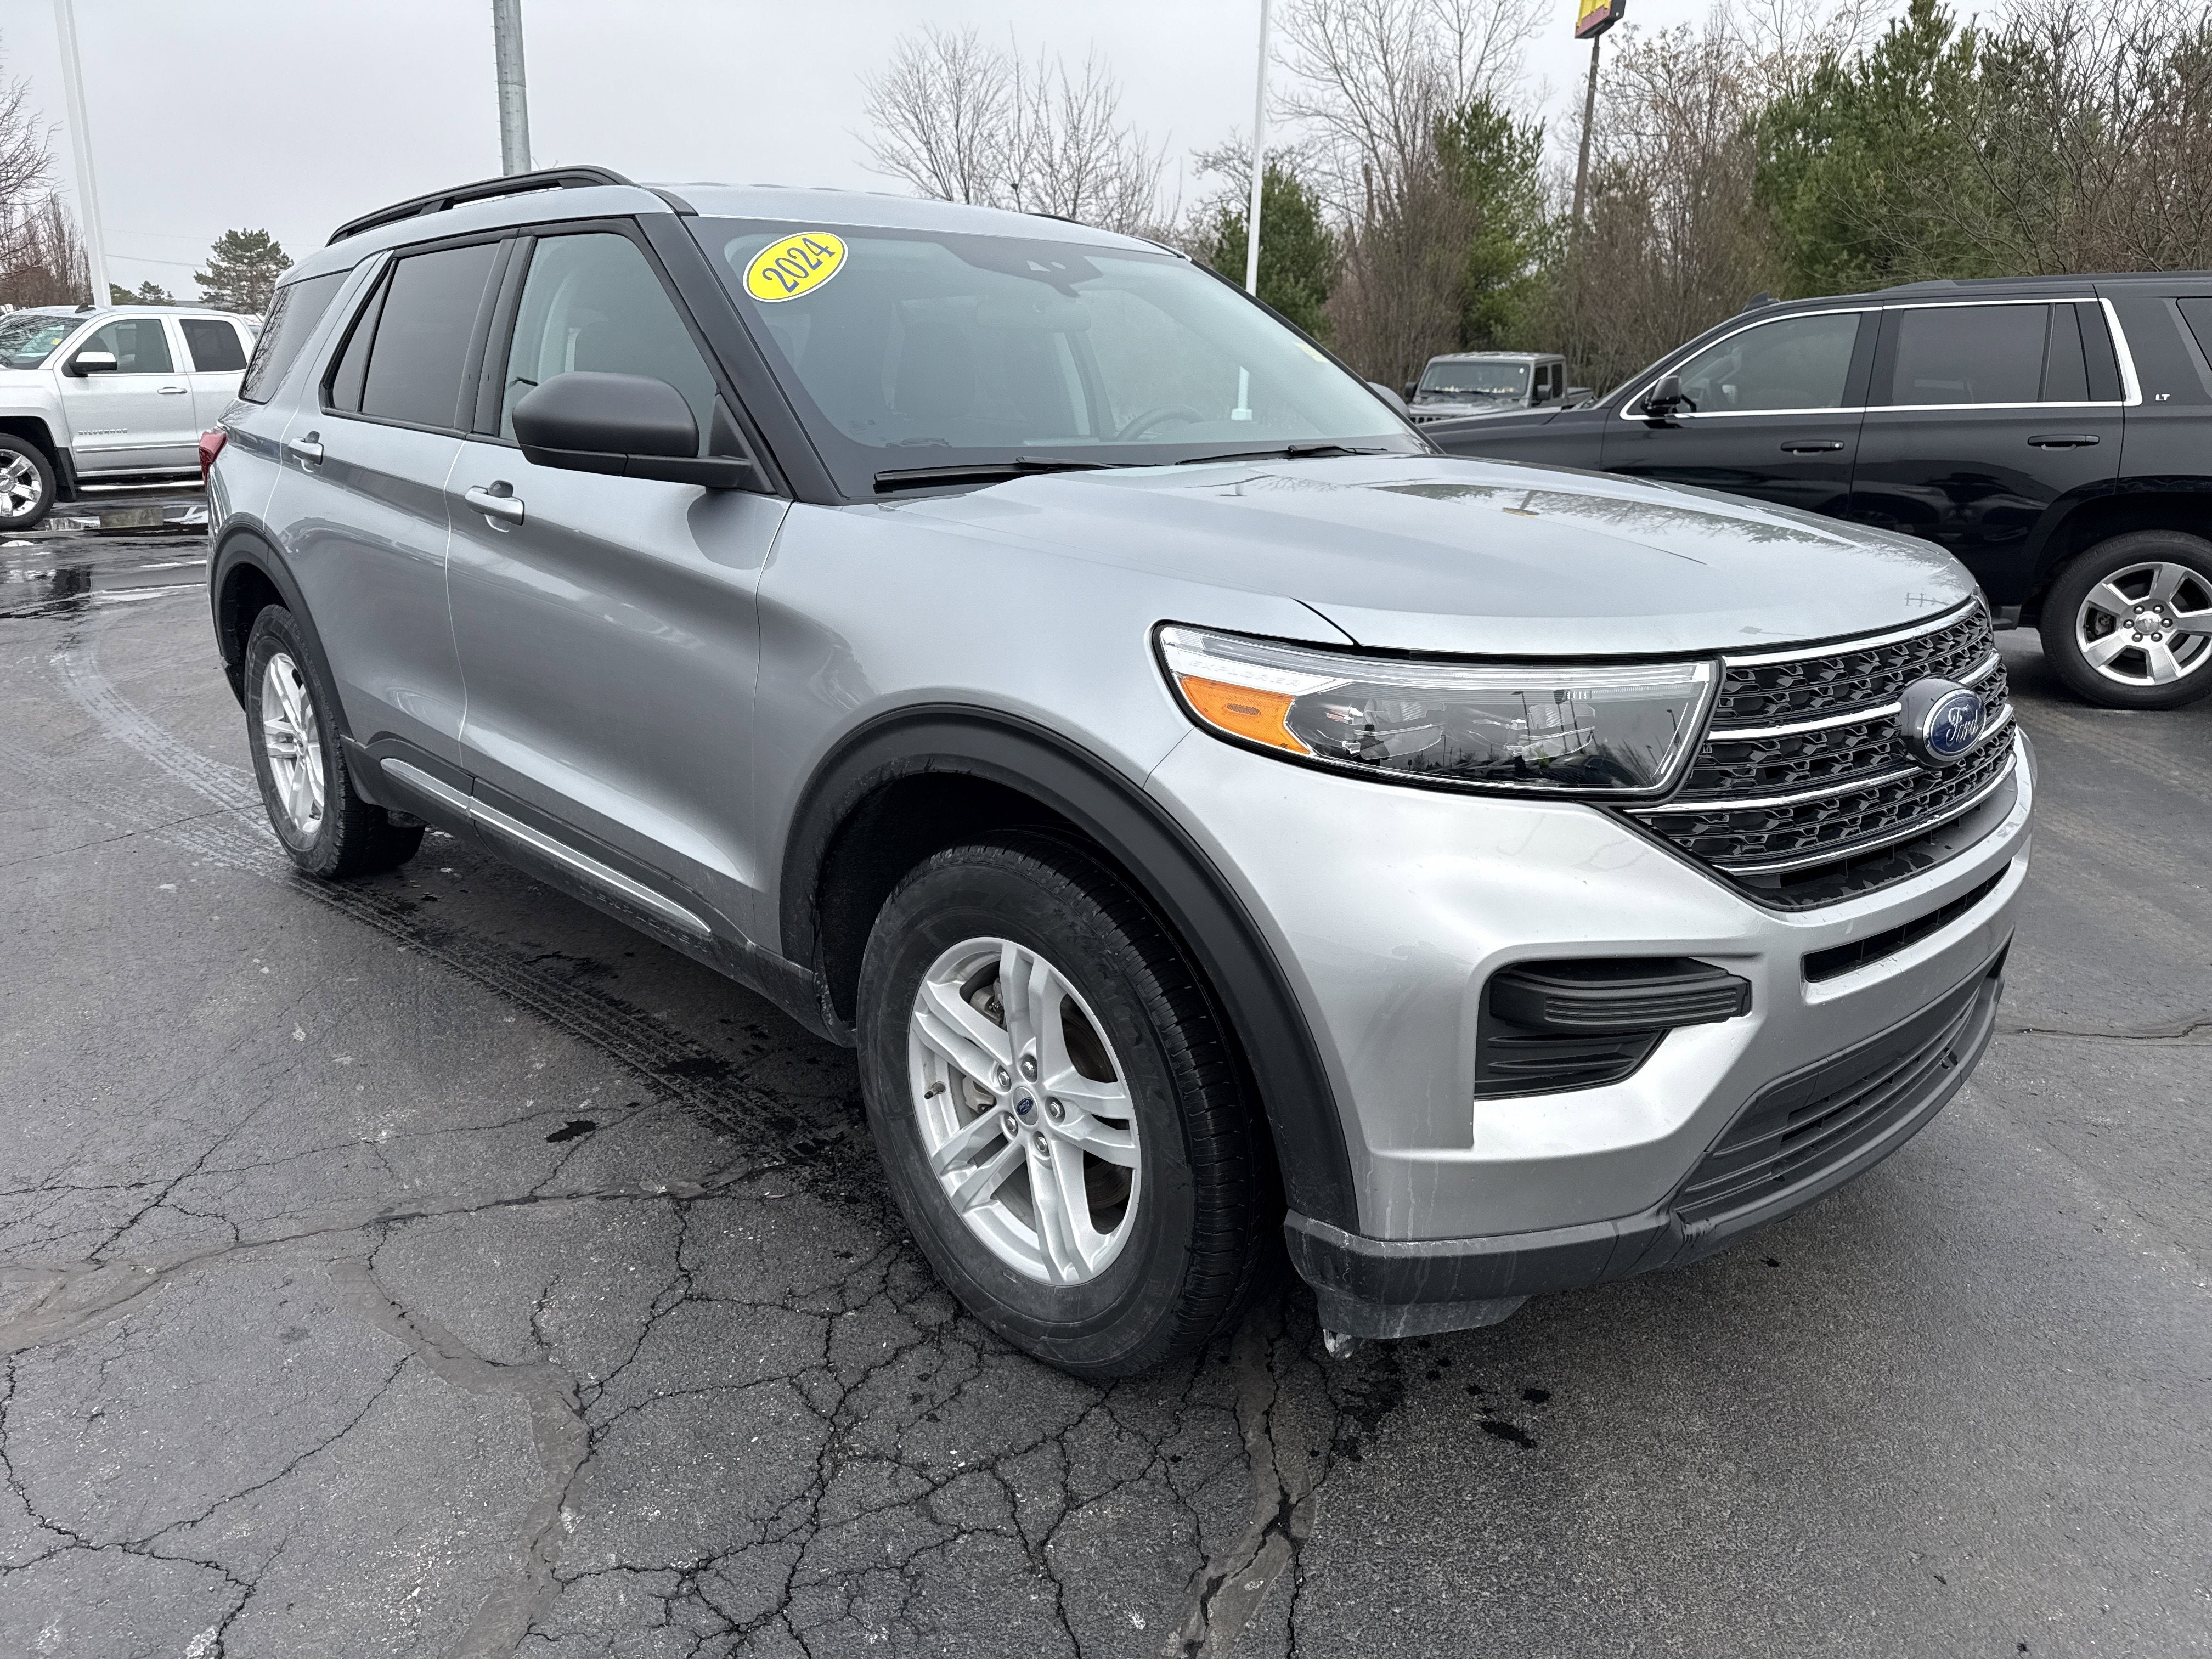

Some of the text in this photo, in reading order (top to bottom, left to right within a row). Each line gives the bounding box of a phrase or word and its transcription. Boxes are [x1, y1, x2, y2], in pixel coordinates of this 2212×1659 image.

[762, 237, 836, 293] 2024
[1189, 660, 1300, 687] EXPLORER
[1945, 704, 1979, 747] Ford
